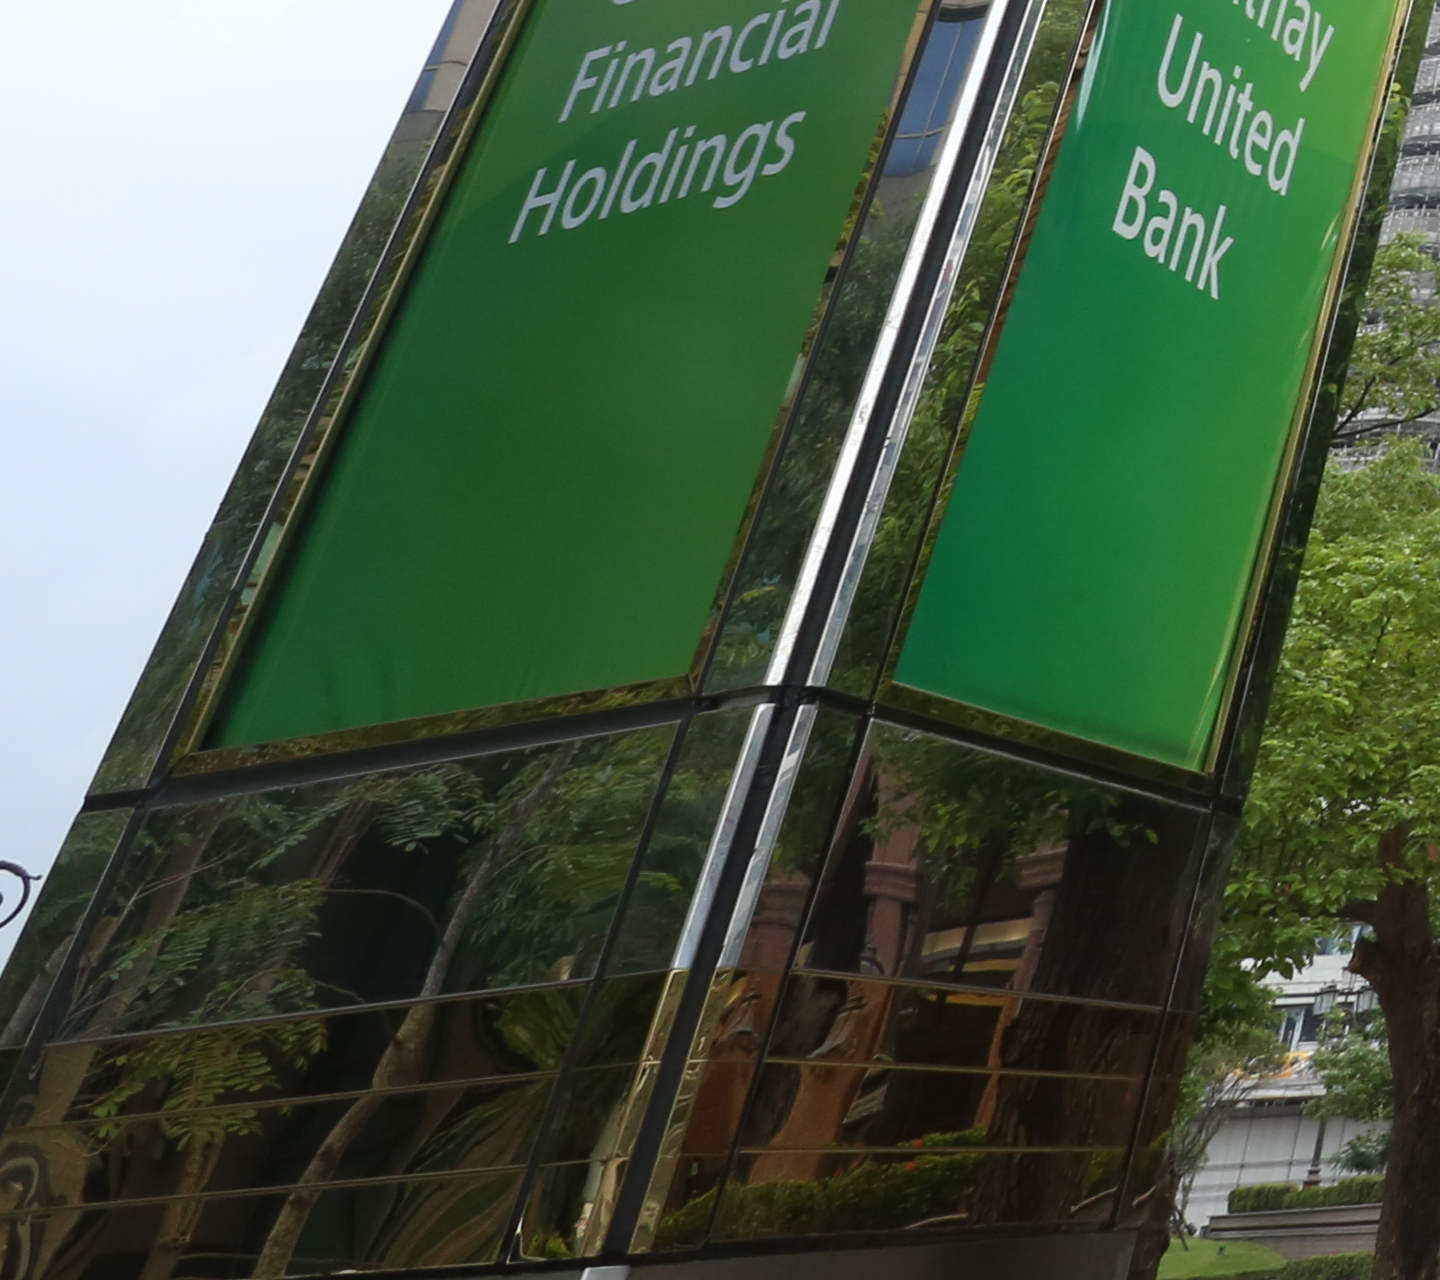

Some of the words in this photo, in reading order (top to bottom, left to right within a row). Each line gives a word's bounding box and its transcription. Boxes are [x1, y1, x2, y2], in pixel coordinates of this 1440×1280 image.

[508, 111, 806, 244] Holdings
[1157, 14, 1305, 196] United
[1112, 145, 1234, 299] Bank
